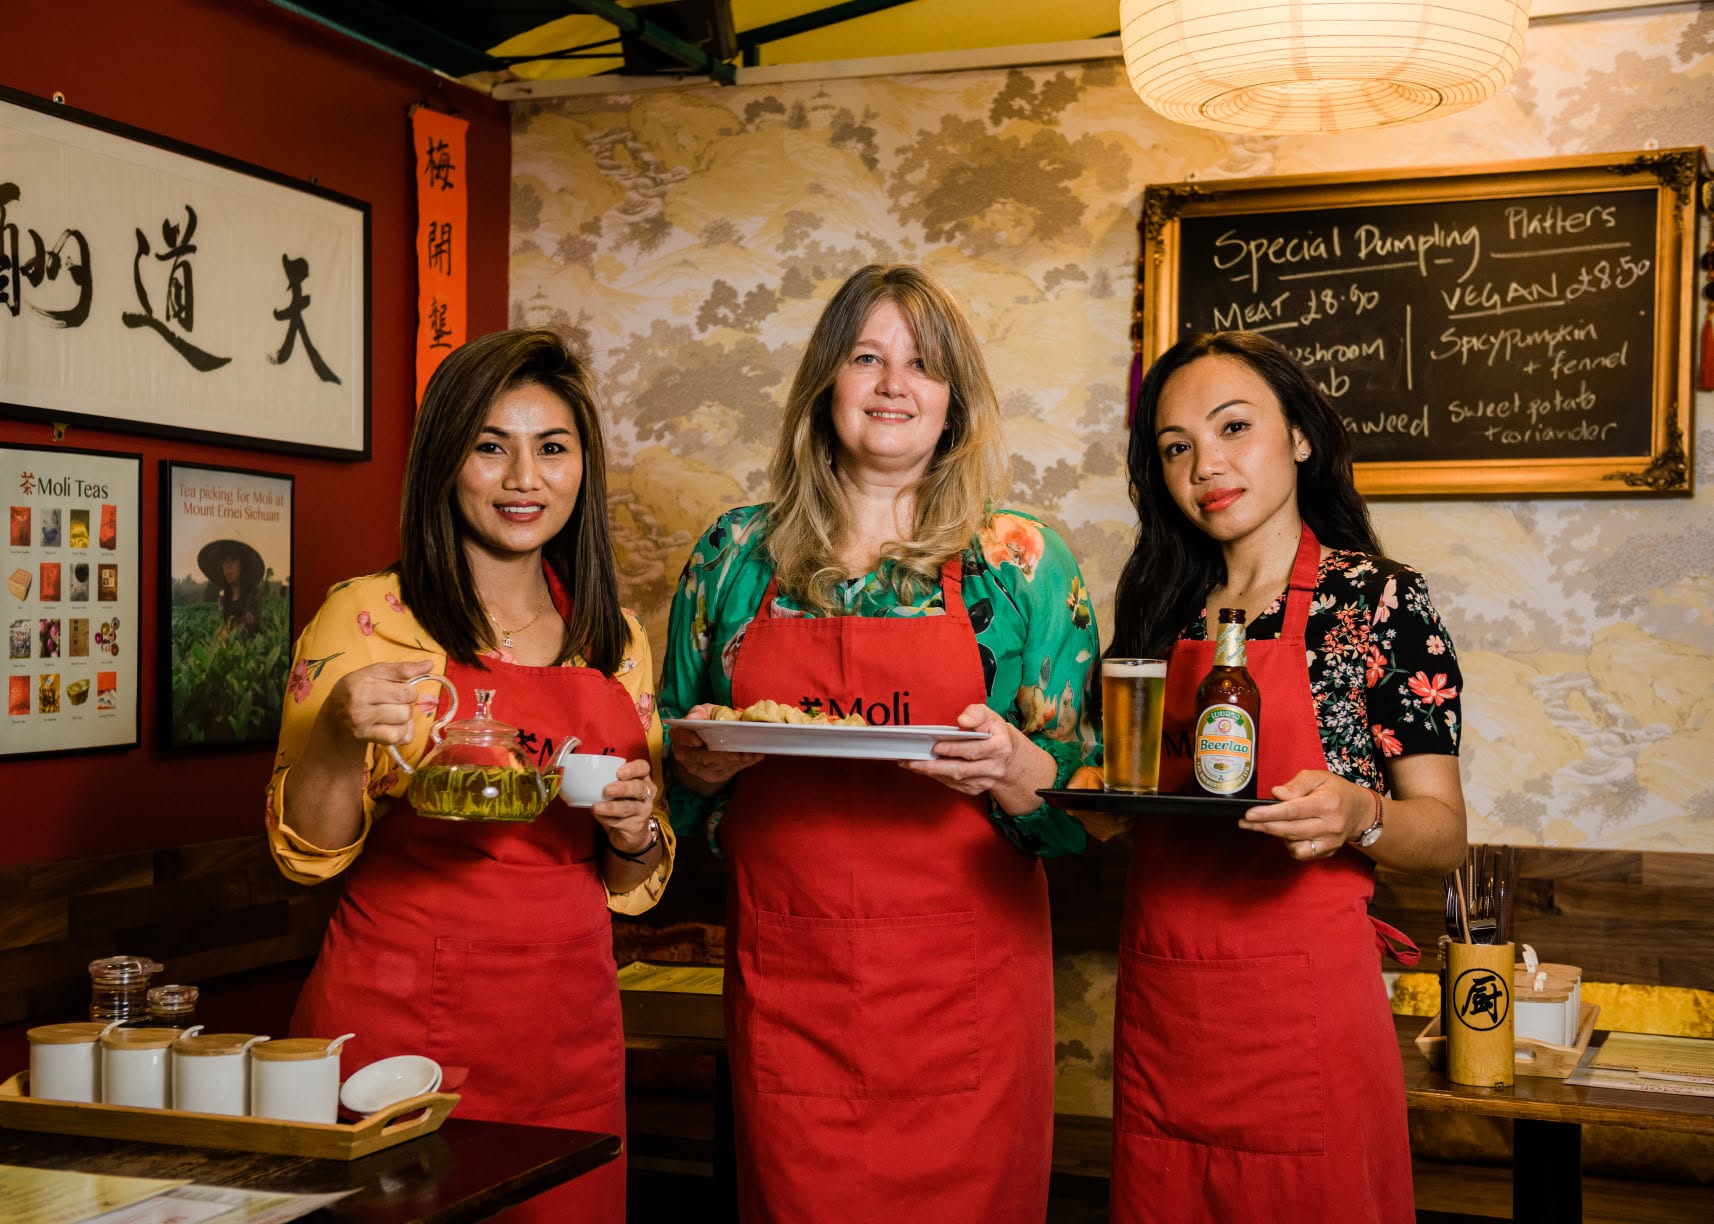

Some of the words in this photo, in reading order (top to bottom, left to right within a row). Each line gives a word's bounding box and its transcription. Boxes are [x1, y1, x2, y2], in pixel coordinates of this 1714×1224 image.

[1213, 225, 1341, 293] Special
[1354, 222, 1480, 283] Dumpling
[1504, 206, 1617, 240] Platters
[1441, 272, 1558, 315] VEGAN
[1279, 338, 1385, 366] ushroom
[1551, 341, 1629, 380] fennel
[1527, 380, 1597, 425] potato
[38, 477, 71, 497] Moli
[75, 480, 109, 499] Teas
[180, 484, 196, 498] Tea
[199, 485, 233, 505] picking
[237, 487, 251, 503] for
[253, 489, 273, 505] Moli
[275, 493, 284, 506] at
[183, 502, 215, 517] Mount
[217, 505, 242, 519] Emei
[245, 505, 280, 522] Sichuan
[1200, 739, 1249, 753] Beerlao
